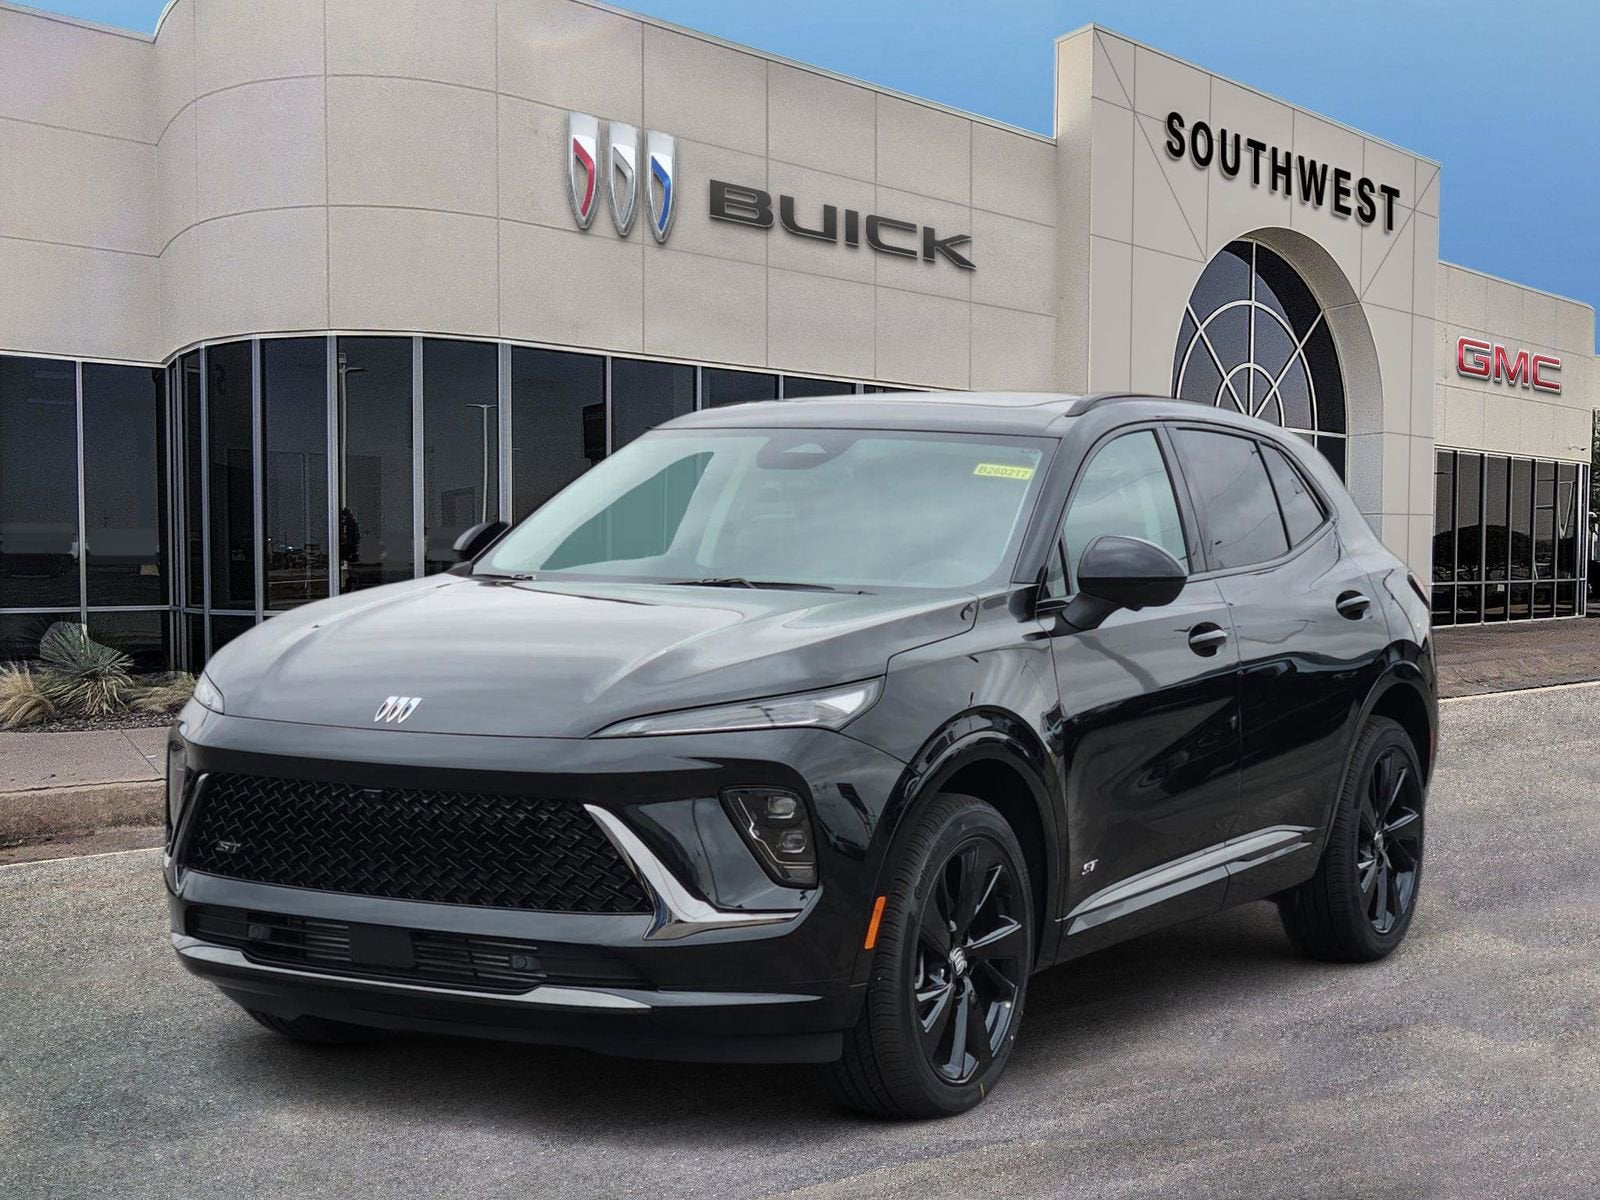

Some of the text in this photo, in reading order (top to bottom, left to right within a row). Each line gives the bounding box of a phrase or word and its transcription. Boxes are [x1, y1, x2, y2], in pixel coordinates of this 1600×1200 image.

[1166, 111, 1400, 231] SOUTHWEST
[709, 179, 977, 270] BUICK
[1457, 336, 1561, 395] GMC
[978, 465, 1029, 478] B260217
